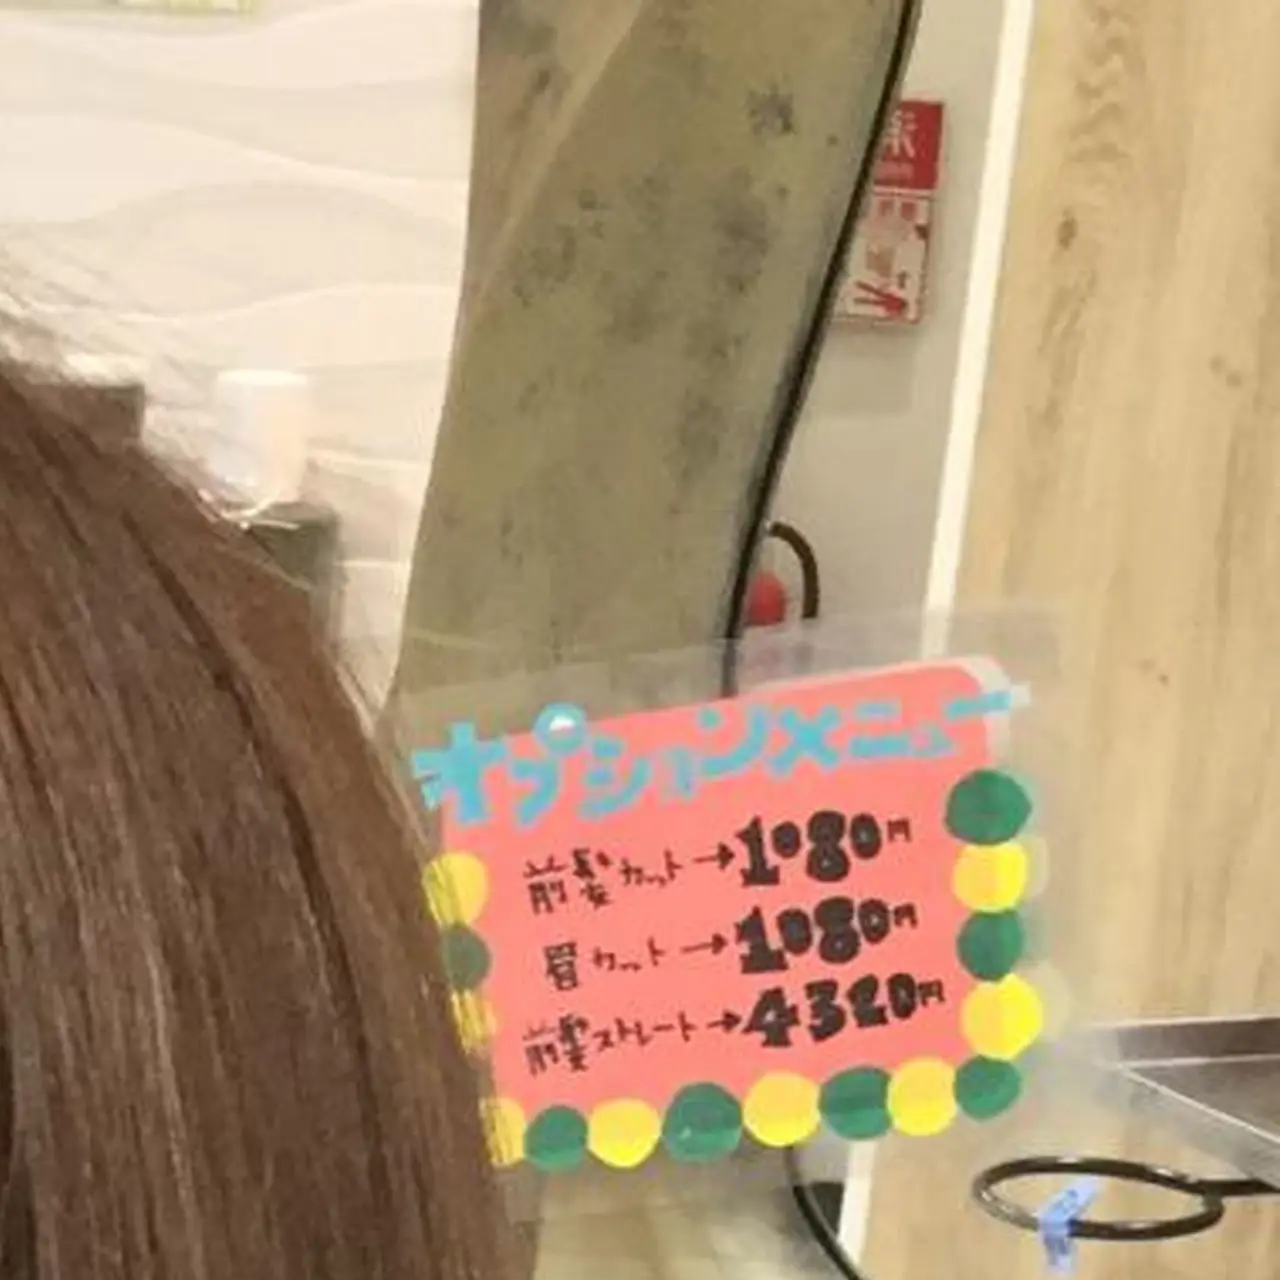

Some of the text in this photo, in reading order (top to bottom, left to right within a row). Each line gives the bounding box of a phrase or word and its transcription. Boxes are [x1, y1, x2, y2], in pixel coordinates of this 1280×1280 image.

[411, 690, 1011, 827] オプションメニュー
[735, 811, 912, 887] 1080円
[735, 895, 918, 974] 1080円
